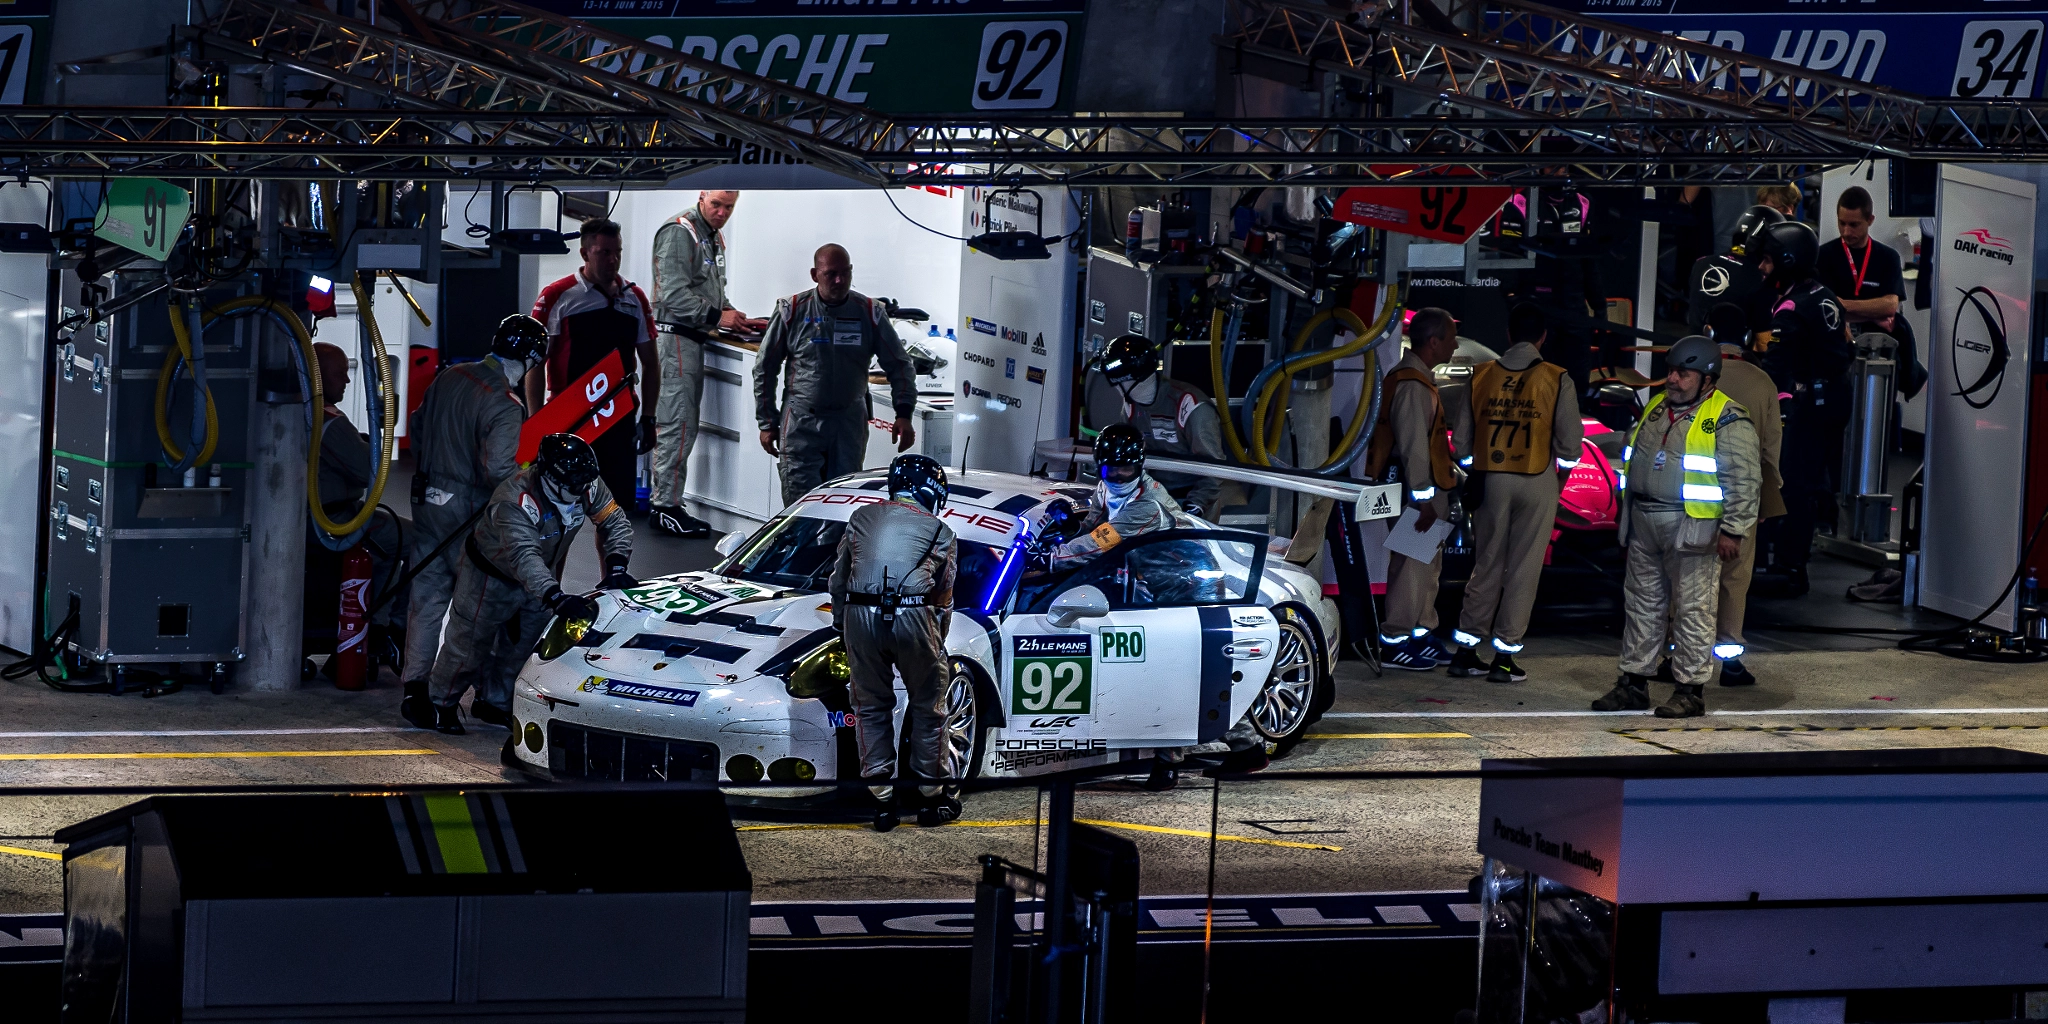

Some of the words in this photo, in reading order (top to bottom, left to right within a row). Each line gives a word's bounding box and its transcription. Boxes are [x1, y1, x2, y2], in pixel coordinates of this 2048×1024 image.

[583, 0, 610, 9] 13-14
[613, 0, 637, 9] JUIN
[640, 0, 664, 9] 2015
[977, 29, 1062, 101] 92
[1957, 29, 2039, 98] 34
[143, 185, 167, 252] 91
[1420, 187, 1468, 235] 92
[982, 215, 1003, 232] Ptrick
[1954, 239, 1978, 255] OAK
[1980, 248, 2014, 265] racing
[1001, 326, 1020, 343] Mobil
[1031, 346, 1047, 356] adidas
[1956, 338, 1991, 354] LIGIER
[964, 352, 995, 367] CHOPARD
[972, 387, 991, 399] SCANIA
[997, 394, 1021, 408] RECARO
[1488, 399, 1536, 409] MARSHAL
[1519, 410, 1542, 419] TRACK
[1488, 420, 1531, 449] 771
[797, 494, 1014, 534] PORHE
[1372, 506, 1391, 515] adidas
[1444, 547, 1473, 555] IDENT
[1018, 639, 1039, 651] 24h
[1041, 643, 1055, 651] LE
[1056, 642, 1087, 651] MANS
[1102, 632, 1143, 658] PRO
[611, 684, 696, 702] MICHELIN
[1021, 661, 1083, 711] 92
[1030, 716, 1080, 727] WEC
[995, 739, 1107, 750] PORSCHE
[1494, 817, 1532, 848] Porsche
[1535, 832, 1560, 858] Team
[1562, 842, 1604, 877] Manthey
